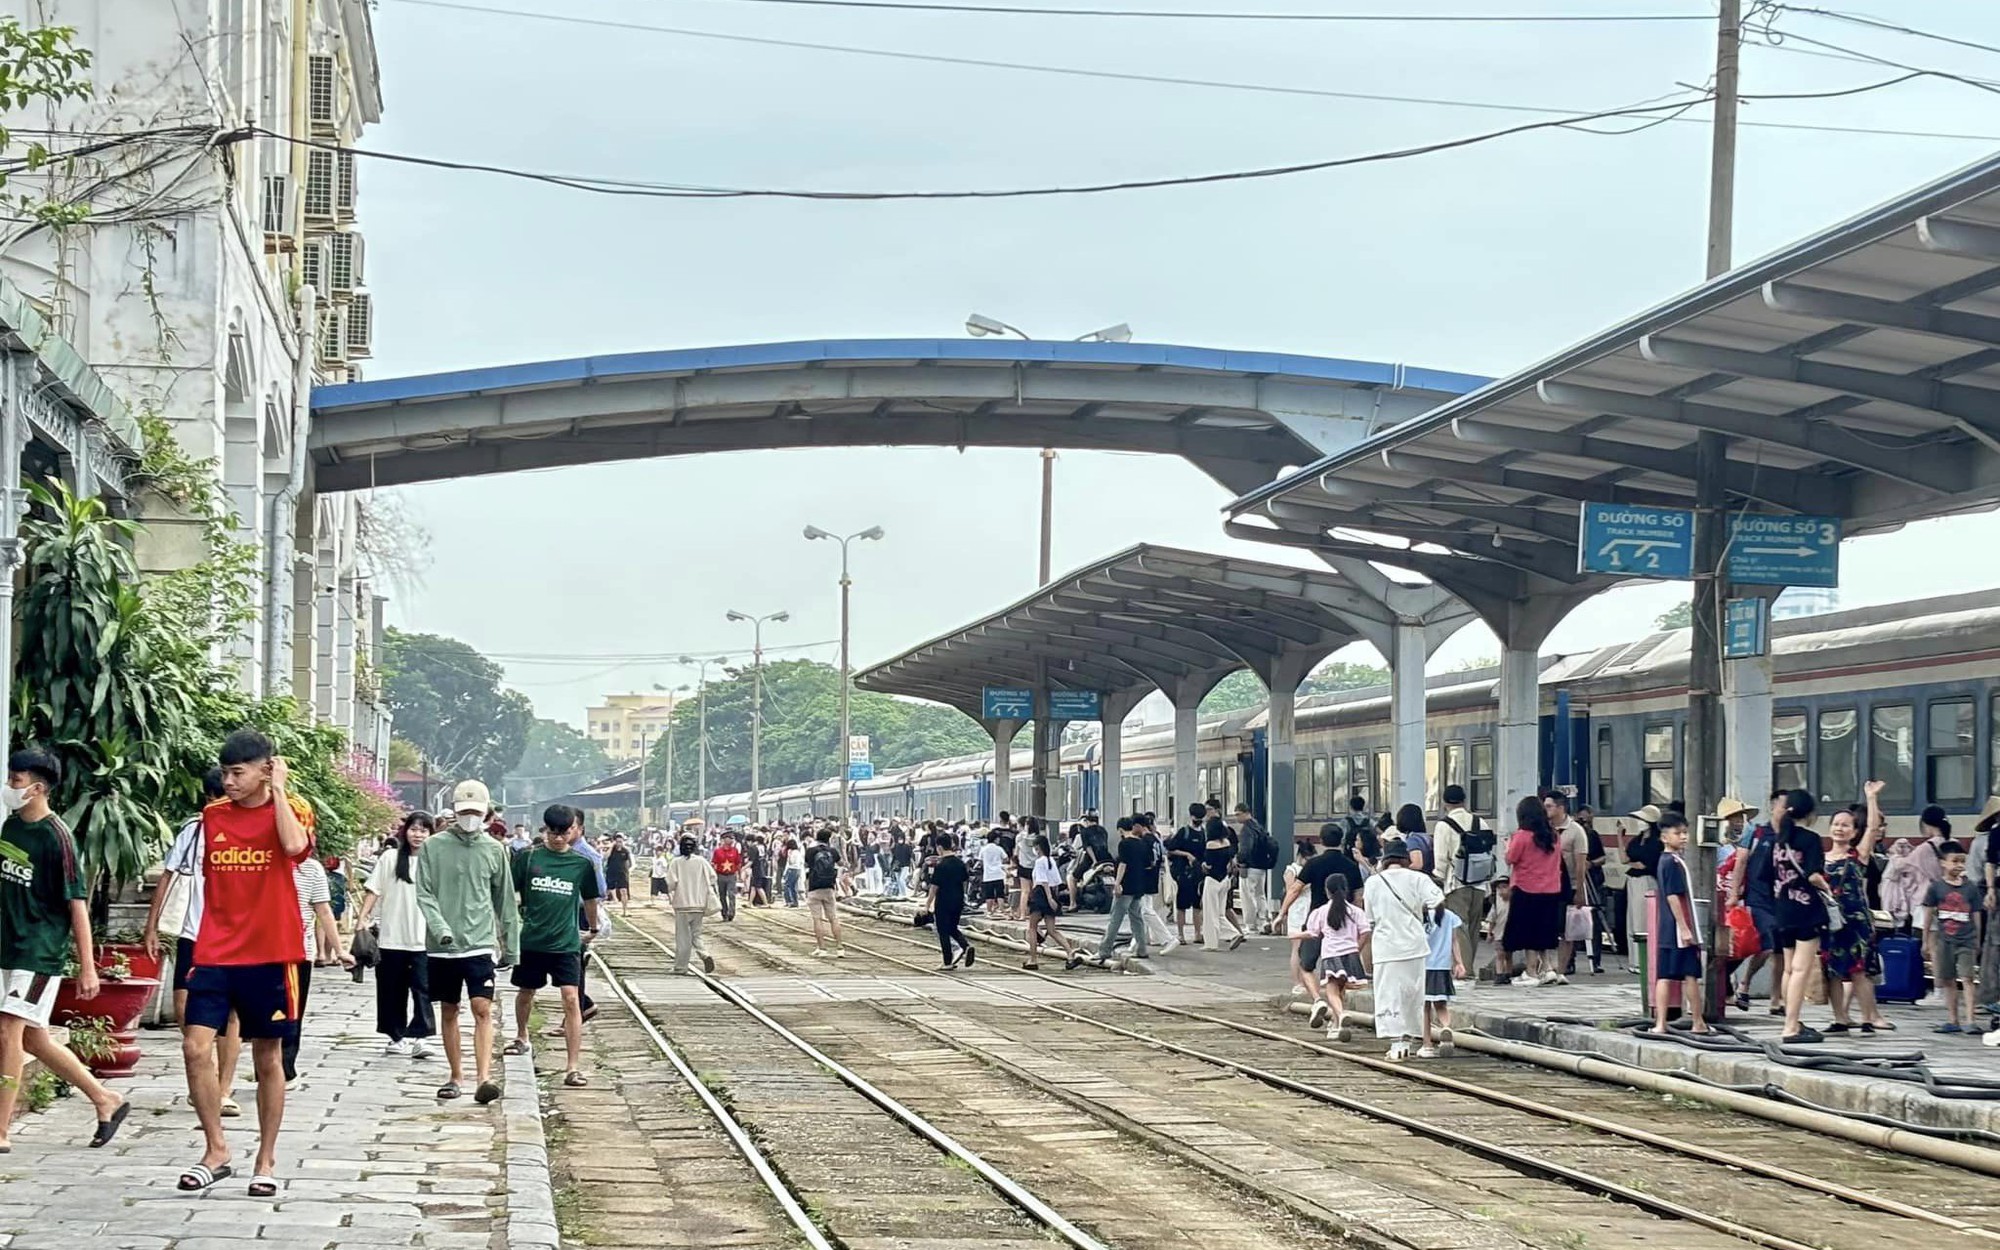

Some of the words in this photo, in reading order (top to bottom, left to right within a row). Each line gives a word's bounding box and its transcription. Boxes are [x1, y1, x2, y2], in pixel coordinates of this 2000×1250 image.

[1598, 510, 1658, 525] ĐƯỜNG
[1662, 513, 1685, 527] SỐ
[1606, 527, 1634, 536] TRACK
[1731, 517, 1791, 533] ĐƯỜNG
[1795, 519, 1816, 534] SỐ
[1818, 523, 1835, 545] 3
[1610, 550, 1621, 566] 1
[1647, 552, 1659, 568] 2
[1089, 692, 1098, 704] 3
[995, 708, 1001, 716] 1
[1012, 708, 1019, 717] 2
[210, 846, 273, 865] adidas
[531, 876, 574, 891] adidas
